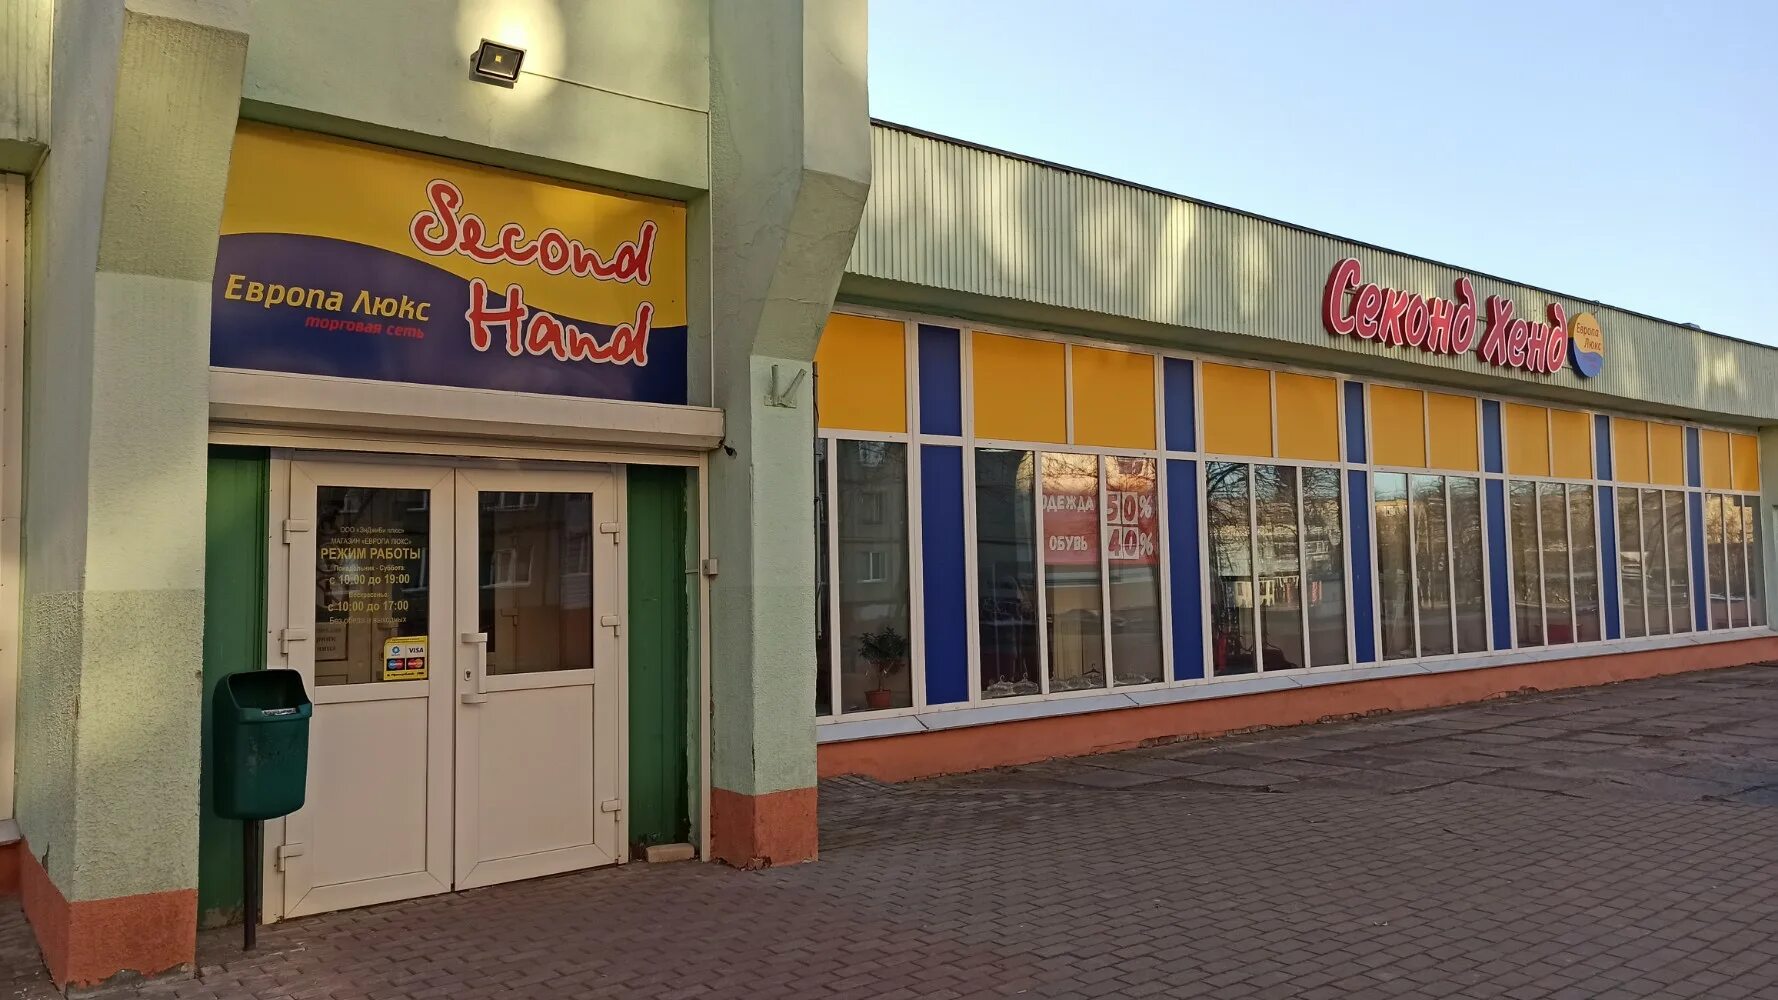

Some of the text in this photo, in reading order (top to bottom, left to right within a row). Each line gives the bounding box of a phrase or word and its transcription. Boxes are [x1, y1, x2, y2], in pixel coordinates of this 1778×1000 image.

[410, 179, 657, 285] Second
[224, 273, 431, 322] Европа Люкс
[465, 278, 654, 366] Hand
[1323, 257, 1568, 373] Секонд Хенд
[304, 315, 425, 339] торговая сеть
[1576, 322, 1599, 337] Европа
[1584, 338, 1601, 350] Люкс
[1107, 493, 1153, 521] 50%
[331, 537, 360, 545] МАГАЗИН
[1049, 535, 1088, 551] ОБУВЬ
[320, 548, 421, 560] РЕЖИМ РАБОТЫ
[368, 576, 381, 586] до
[385, 574, 410, 584] 19:00
[338, 601, 364, 612] 10:00
[366, 603, 380, 612] до
[383, 600, 409, 611] 17:00
